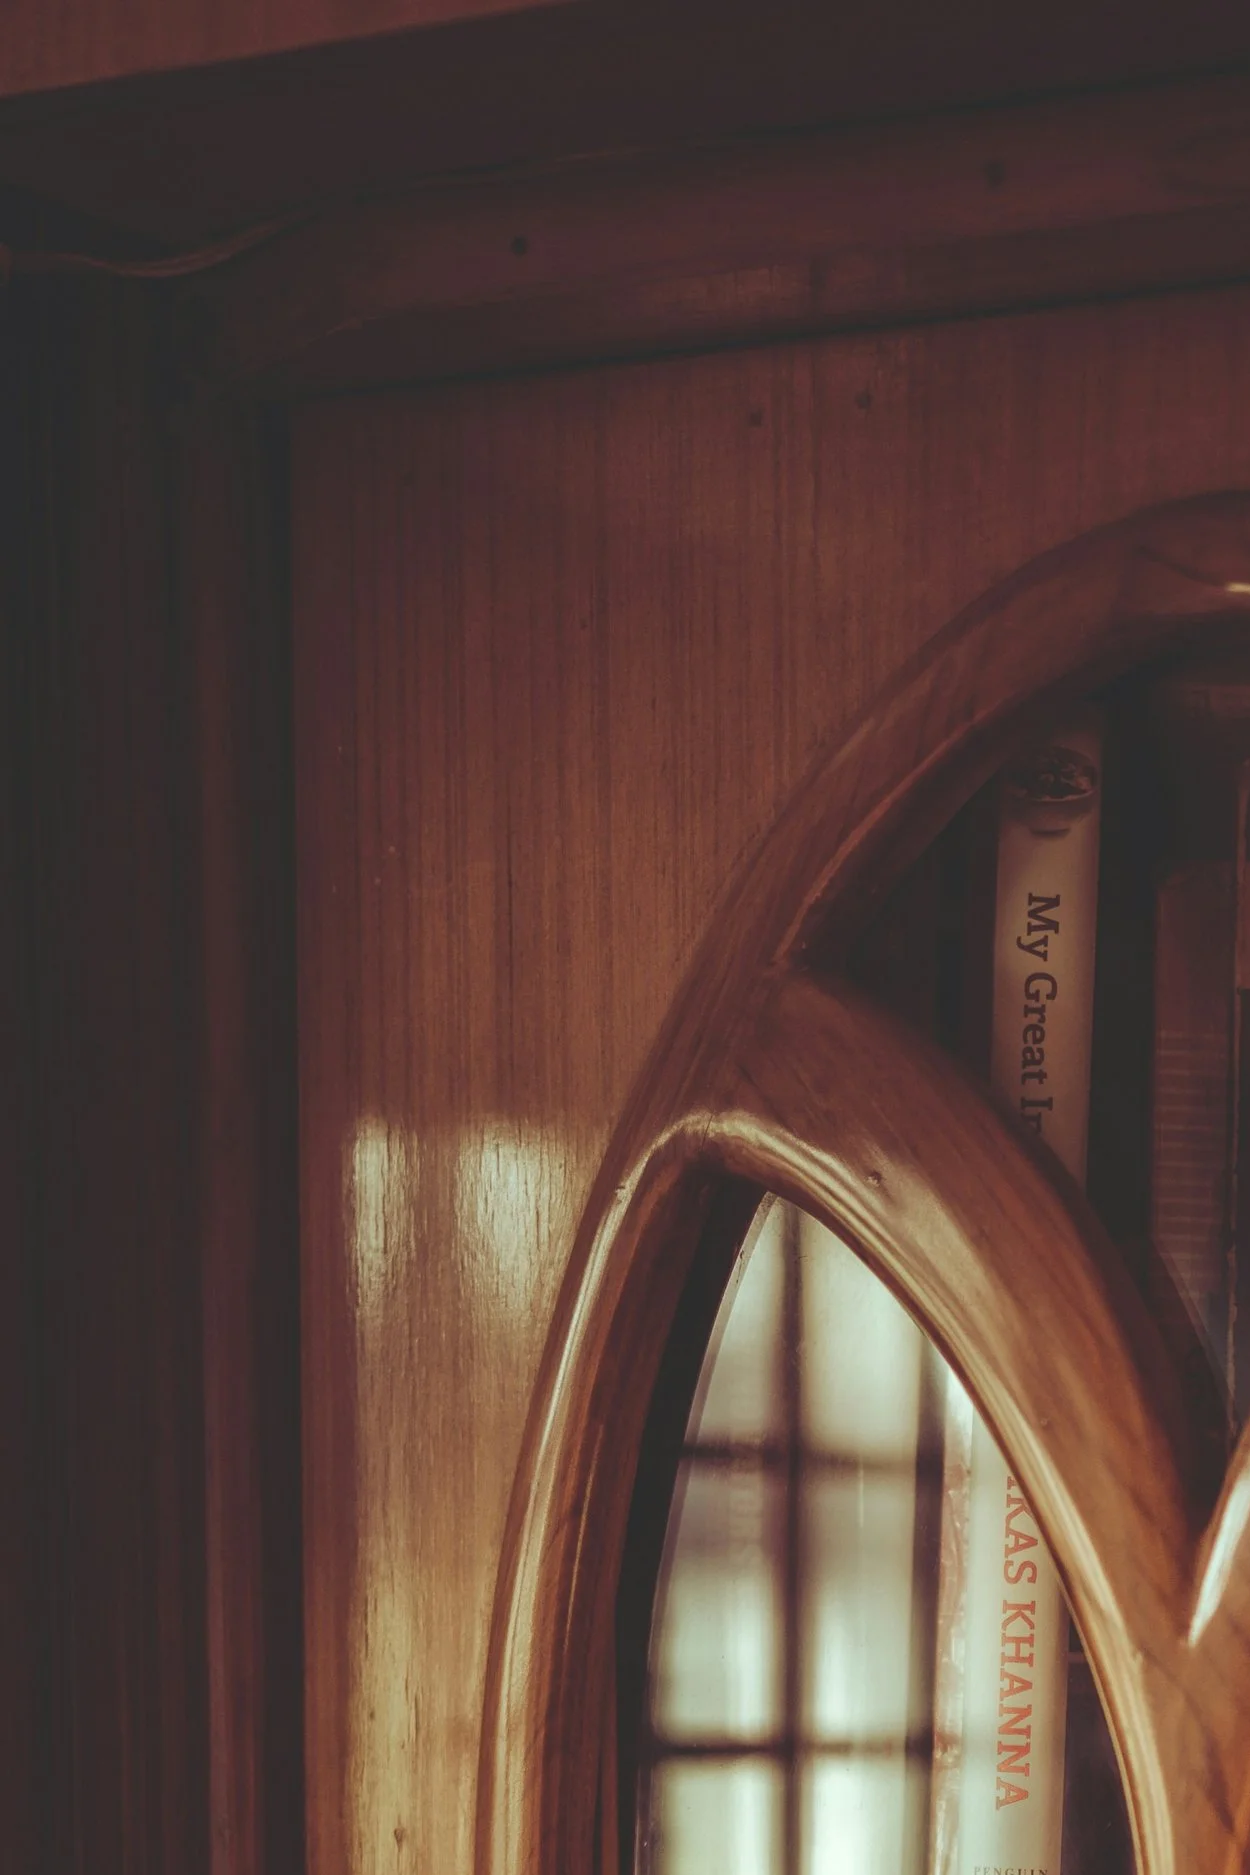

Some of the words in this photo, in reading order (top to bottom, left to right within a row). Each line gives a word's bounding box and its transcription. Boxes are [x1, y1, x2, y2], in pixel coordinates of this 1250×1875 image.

[1016, 892, 1061, 961] My
[1021, 972, 1058, 1084] Great
[996, 1600, 1036, 1811] KHANNA
